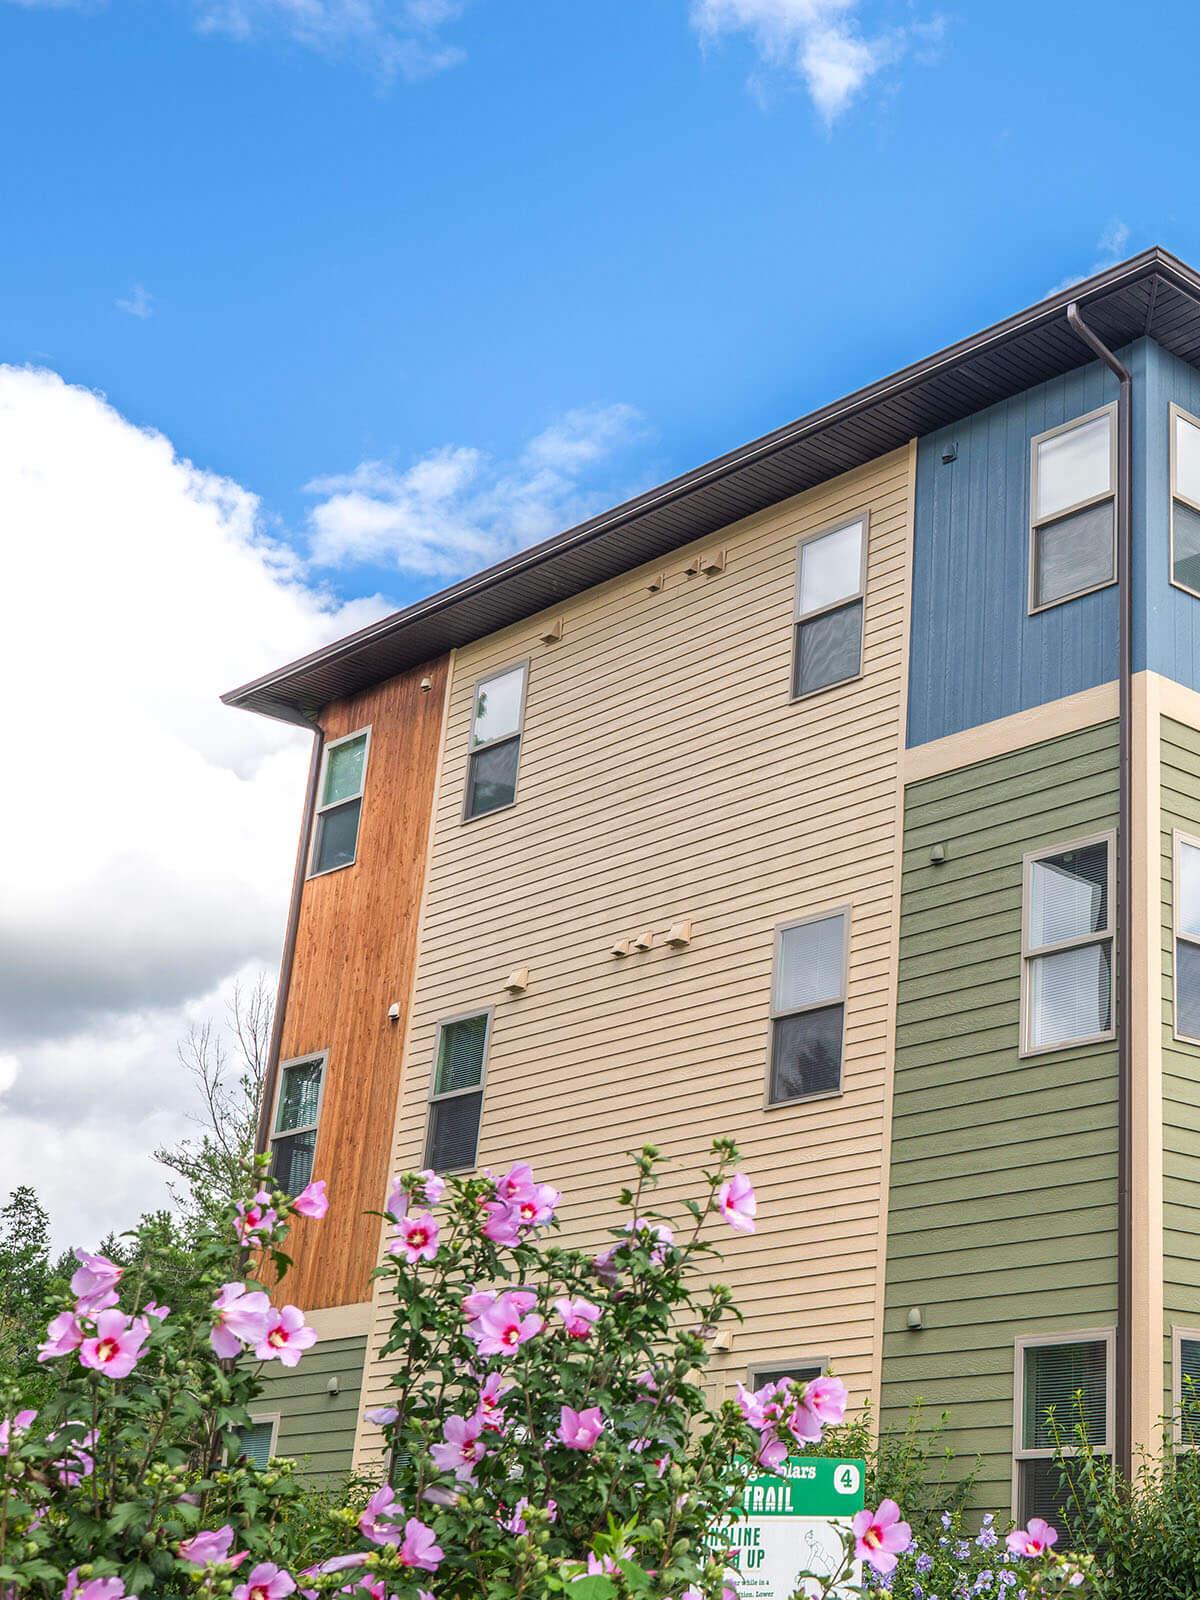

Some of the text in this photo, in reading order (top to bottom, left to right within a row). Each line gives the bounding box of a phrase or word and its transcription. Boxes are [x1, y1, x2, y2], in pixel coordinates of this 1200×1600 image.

[840, 1468, 852, 1488] 4
[743, 1486, 794, 1512] TRAIL
[747, 1549, 765, 1568] UP
